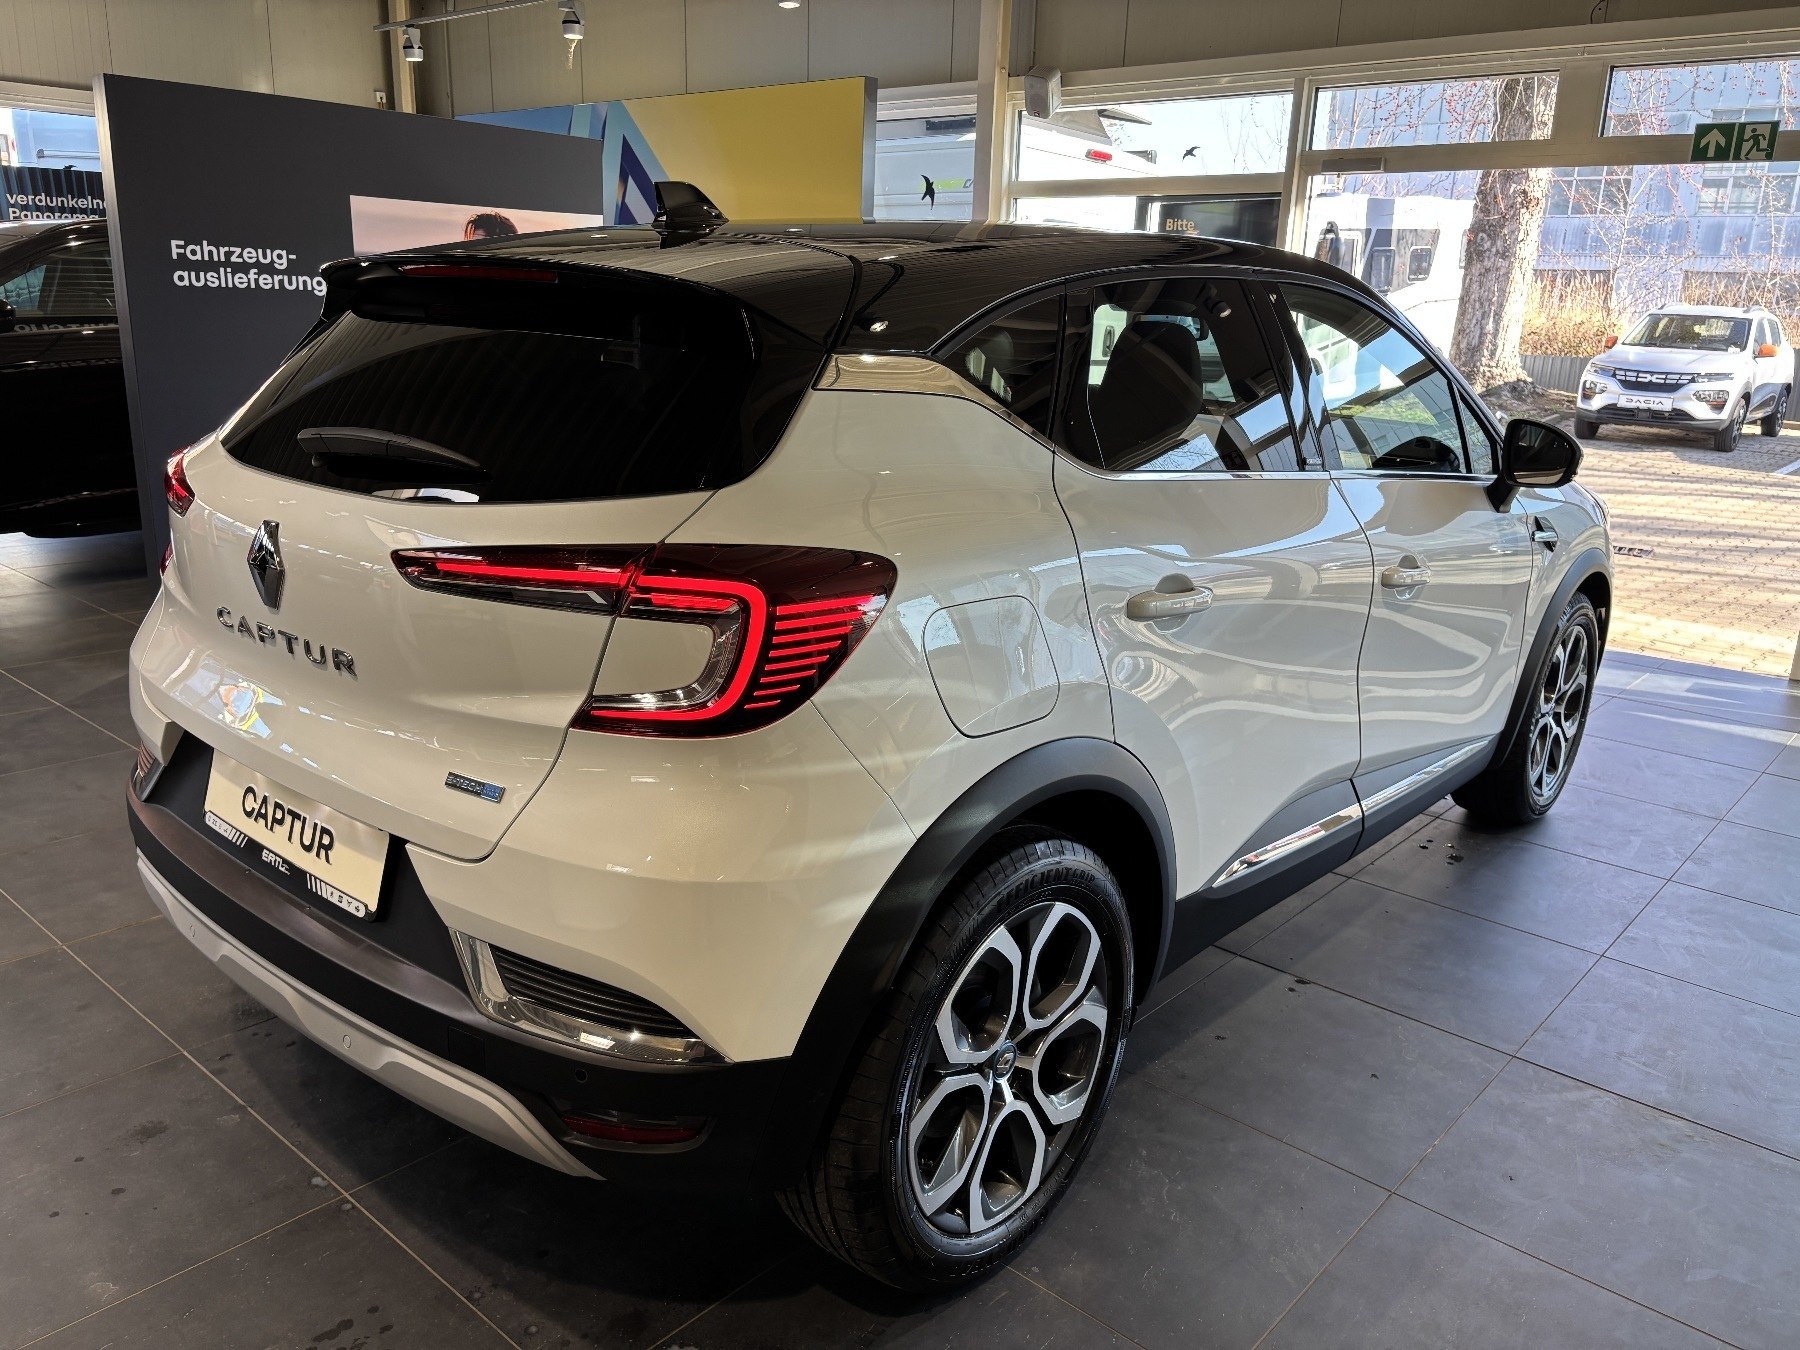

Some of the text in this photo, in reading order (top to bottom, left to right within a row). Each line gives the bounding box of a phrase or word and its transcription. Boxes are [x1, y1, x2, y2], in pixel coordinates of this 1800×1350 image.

[6, 192, 107, 209] verdunkeln
[1165, 218, 1195, 231] Bitte
[170, 239, 297, 270] Fahrzeug-
[173, 267, 327, 297] auslieferung
[1625, 397, 1664, 405] DACIA
[216, 606, 358, 677] CAPTUR
[241, 785, 335, 866] CAPTUR
